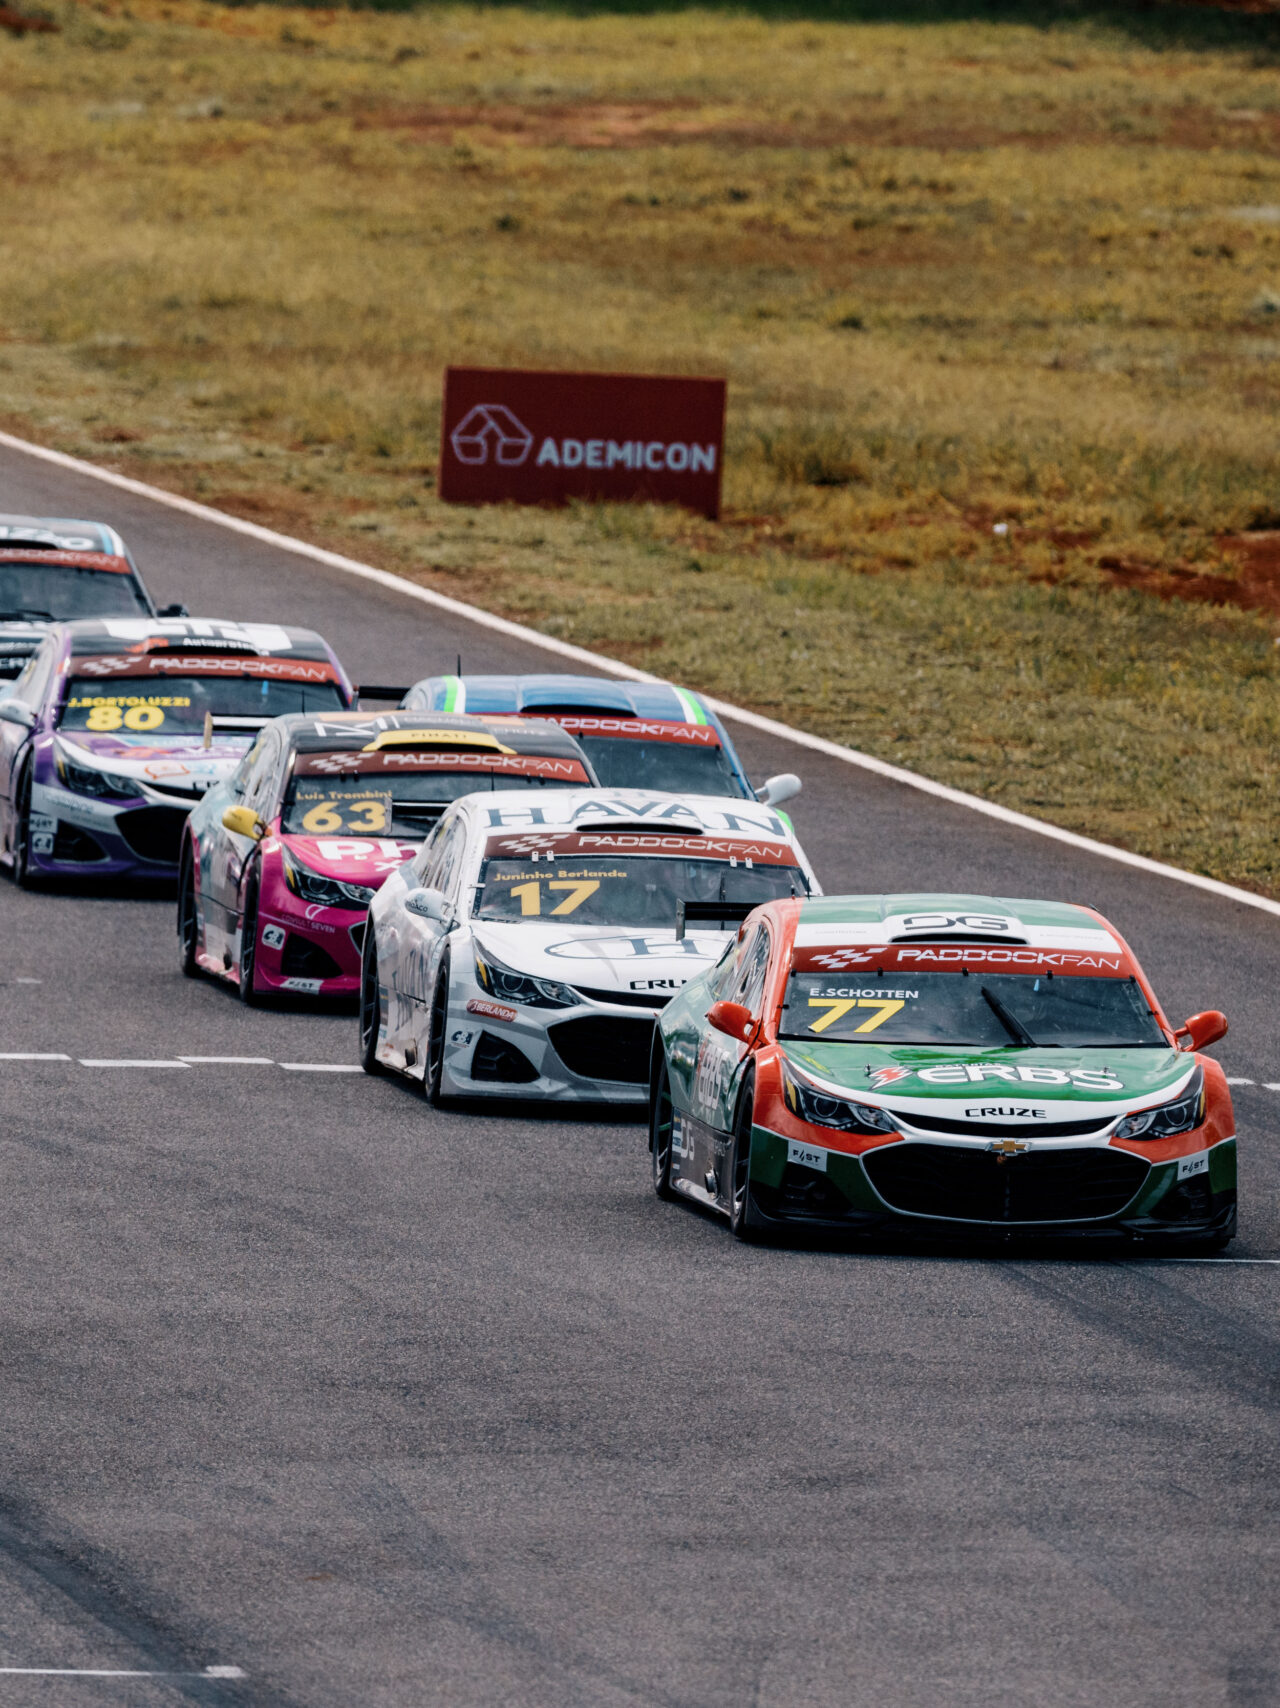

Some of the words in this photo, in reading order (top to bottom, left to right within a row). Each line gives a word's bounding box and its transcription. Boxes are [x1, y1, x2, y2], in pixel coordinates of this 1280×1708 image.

[536, 438, 716, 472] ADEMICON
[150, 658, 326, 680] PADDOCKFAN
[86, 706, 165, 731] 80
[529, 716, 710, 742] ADDOCKFAN
[383, 753, 574, 775] PADDOCKFAN
[297, 791, 324, 800] Luis
[302, 801, 387, 833] 63
[484, 800, 786, 837] HAVAN
[578, 835, 782, 858] PADDOCKFAN
[494, 871, 554, 882] Juninho
[558, 869, 627, 879] Berlanda
[510, 880, 600, 916] 17
[896, 949, 1120, 970] PADDOCKFAN
[809, 987, 919, 999] E.SCHOTTEN
[477, 1003, 515, 1019] BERLANDA
[807, 998, 905, 1033] 77
[917, 1065, 1124, 1091] ERBS
[964, 1108, 1047, 1119] CRUZE
